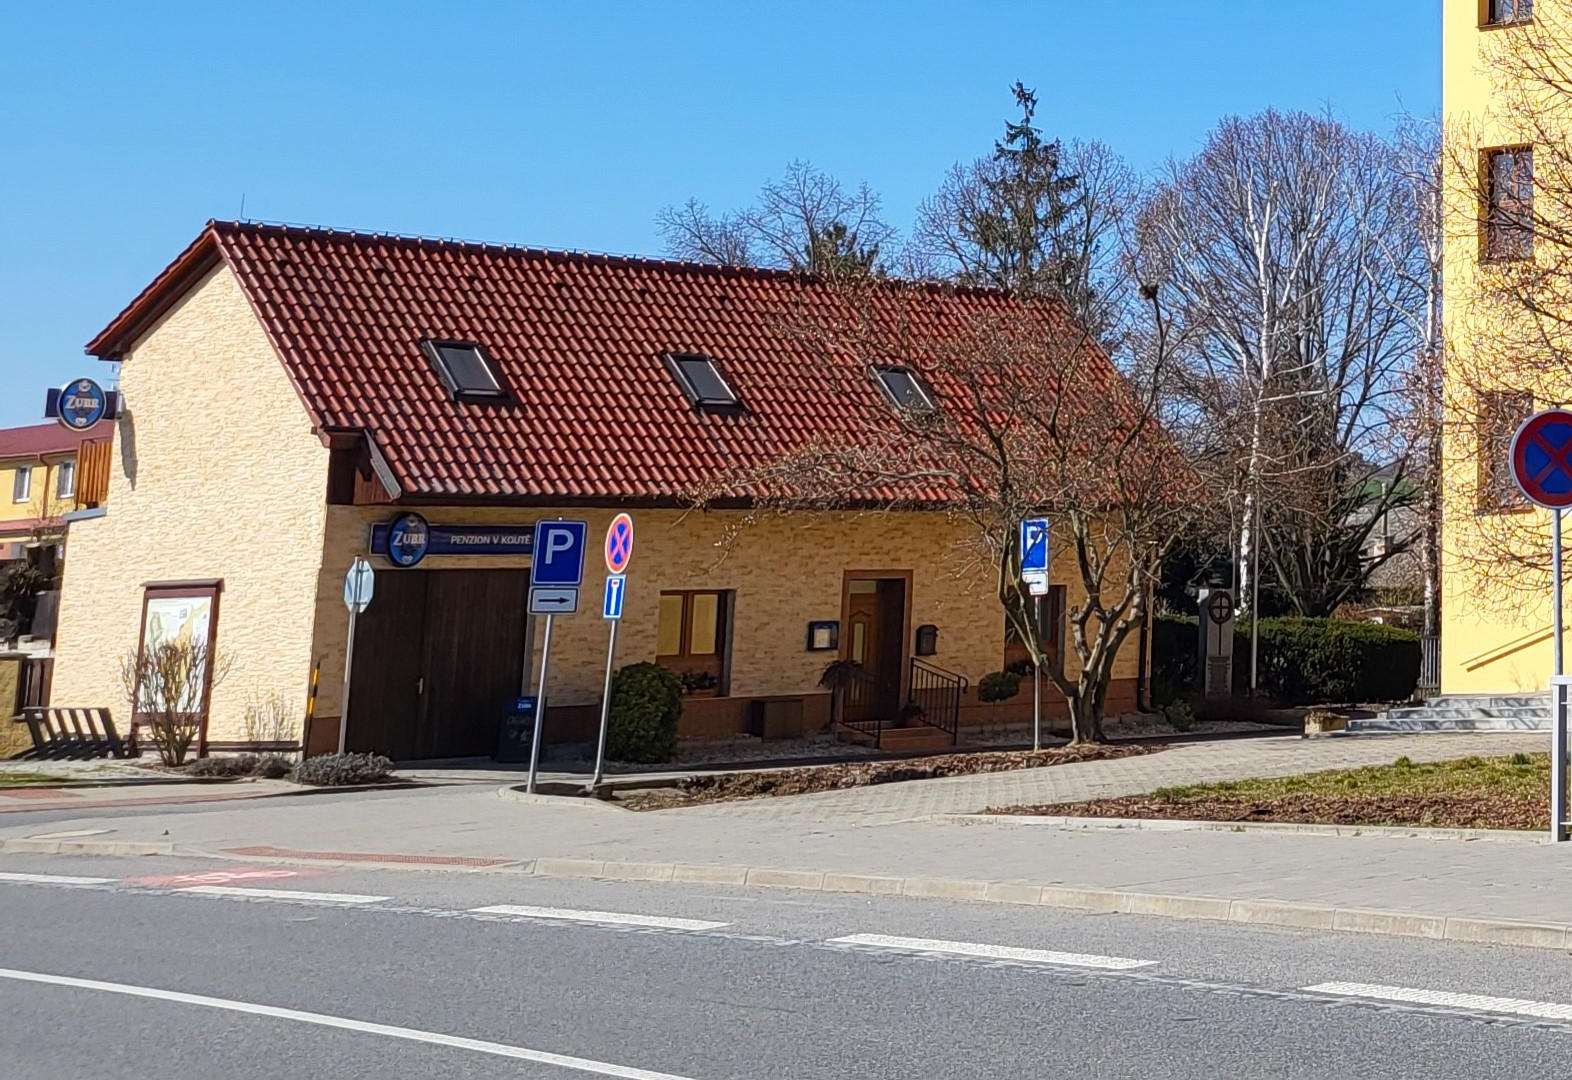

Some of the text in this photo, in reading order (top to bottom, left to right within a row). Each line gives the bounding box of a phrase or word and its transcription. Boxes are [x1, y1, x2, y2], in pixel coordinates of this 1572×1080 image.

[392, 531, 425, 546] ZUBR
[451, 535, 490, 545] PENZION
[492, 535, 500, 545] V
[544, 529, 574, 565] P
[1027, 525, 1043, 560] P
